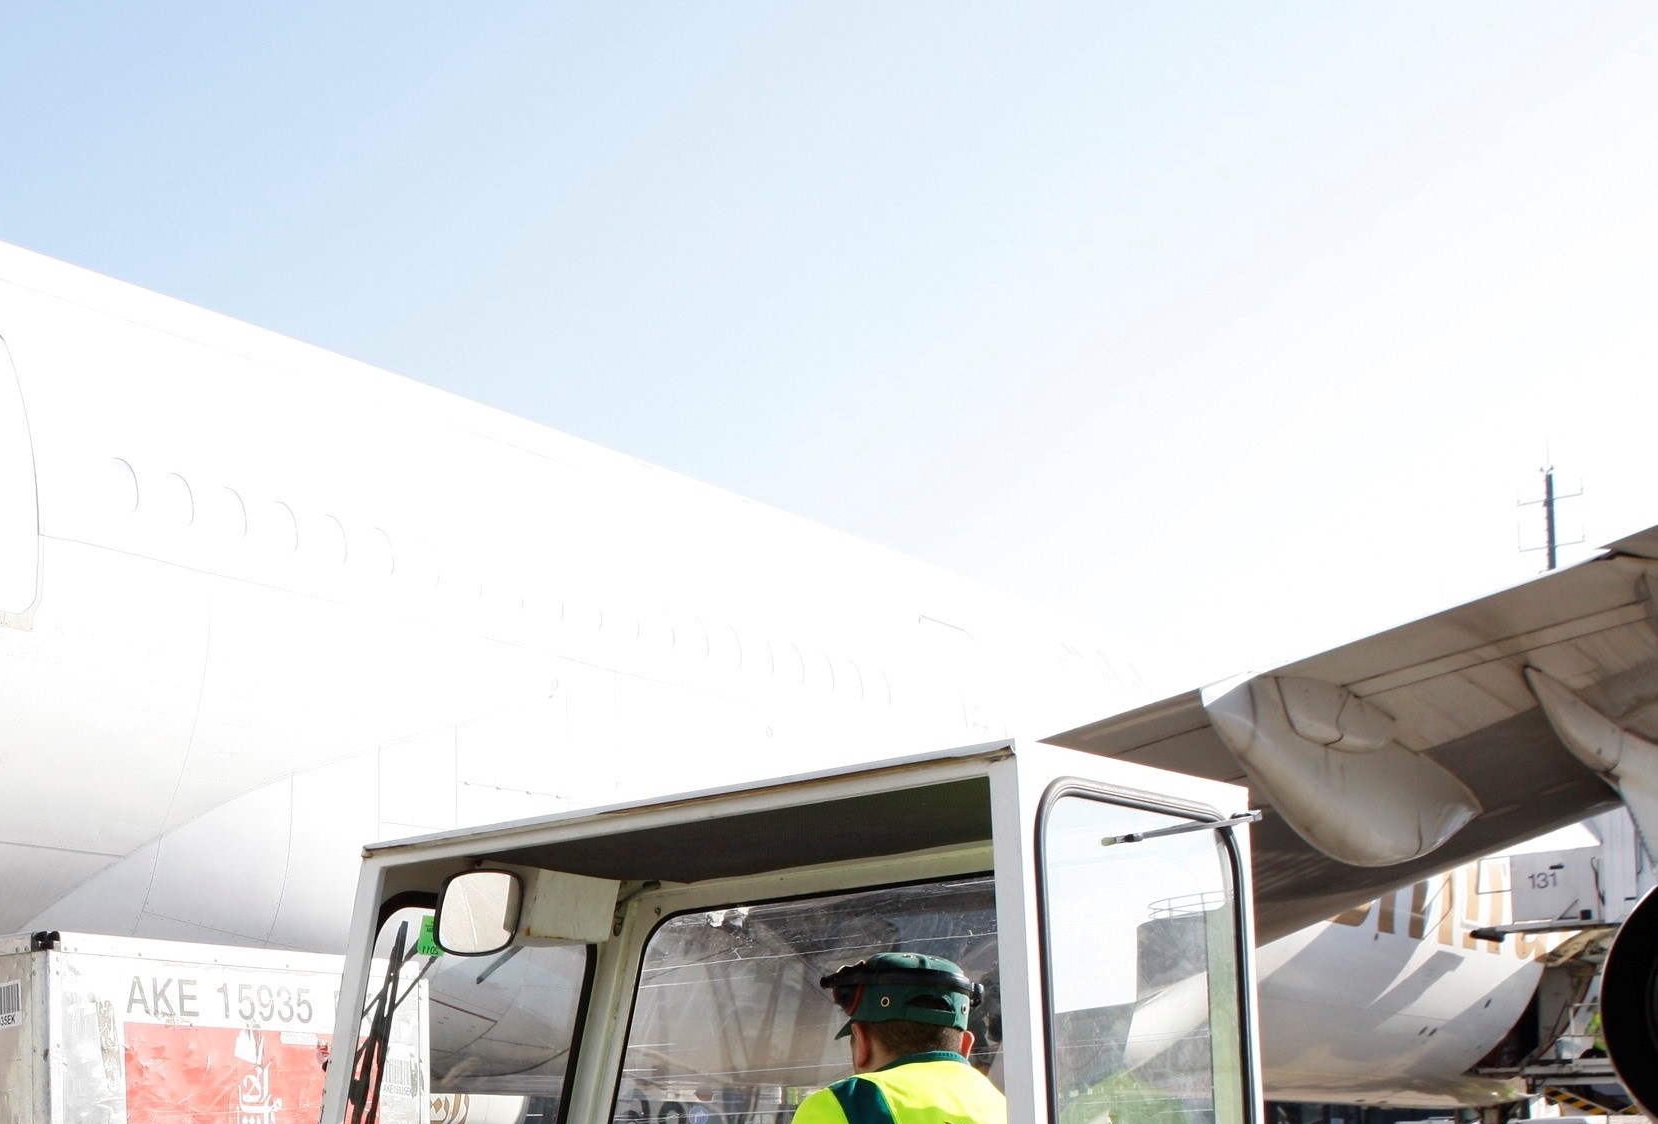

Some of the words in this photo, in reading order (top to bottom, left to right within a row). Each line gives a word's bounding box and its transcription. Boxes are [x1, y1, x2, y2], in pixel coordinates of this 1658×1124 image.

[1528, 871, 1558, 889] 131
[126, 975, 200, 1018] AKE
[217, 982, 313, 1024] 15935
